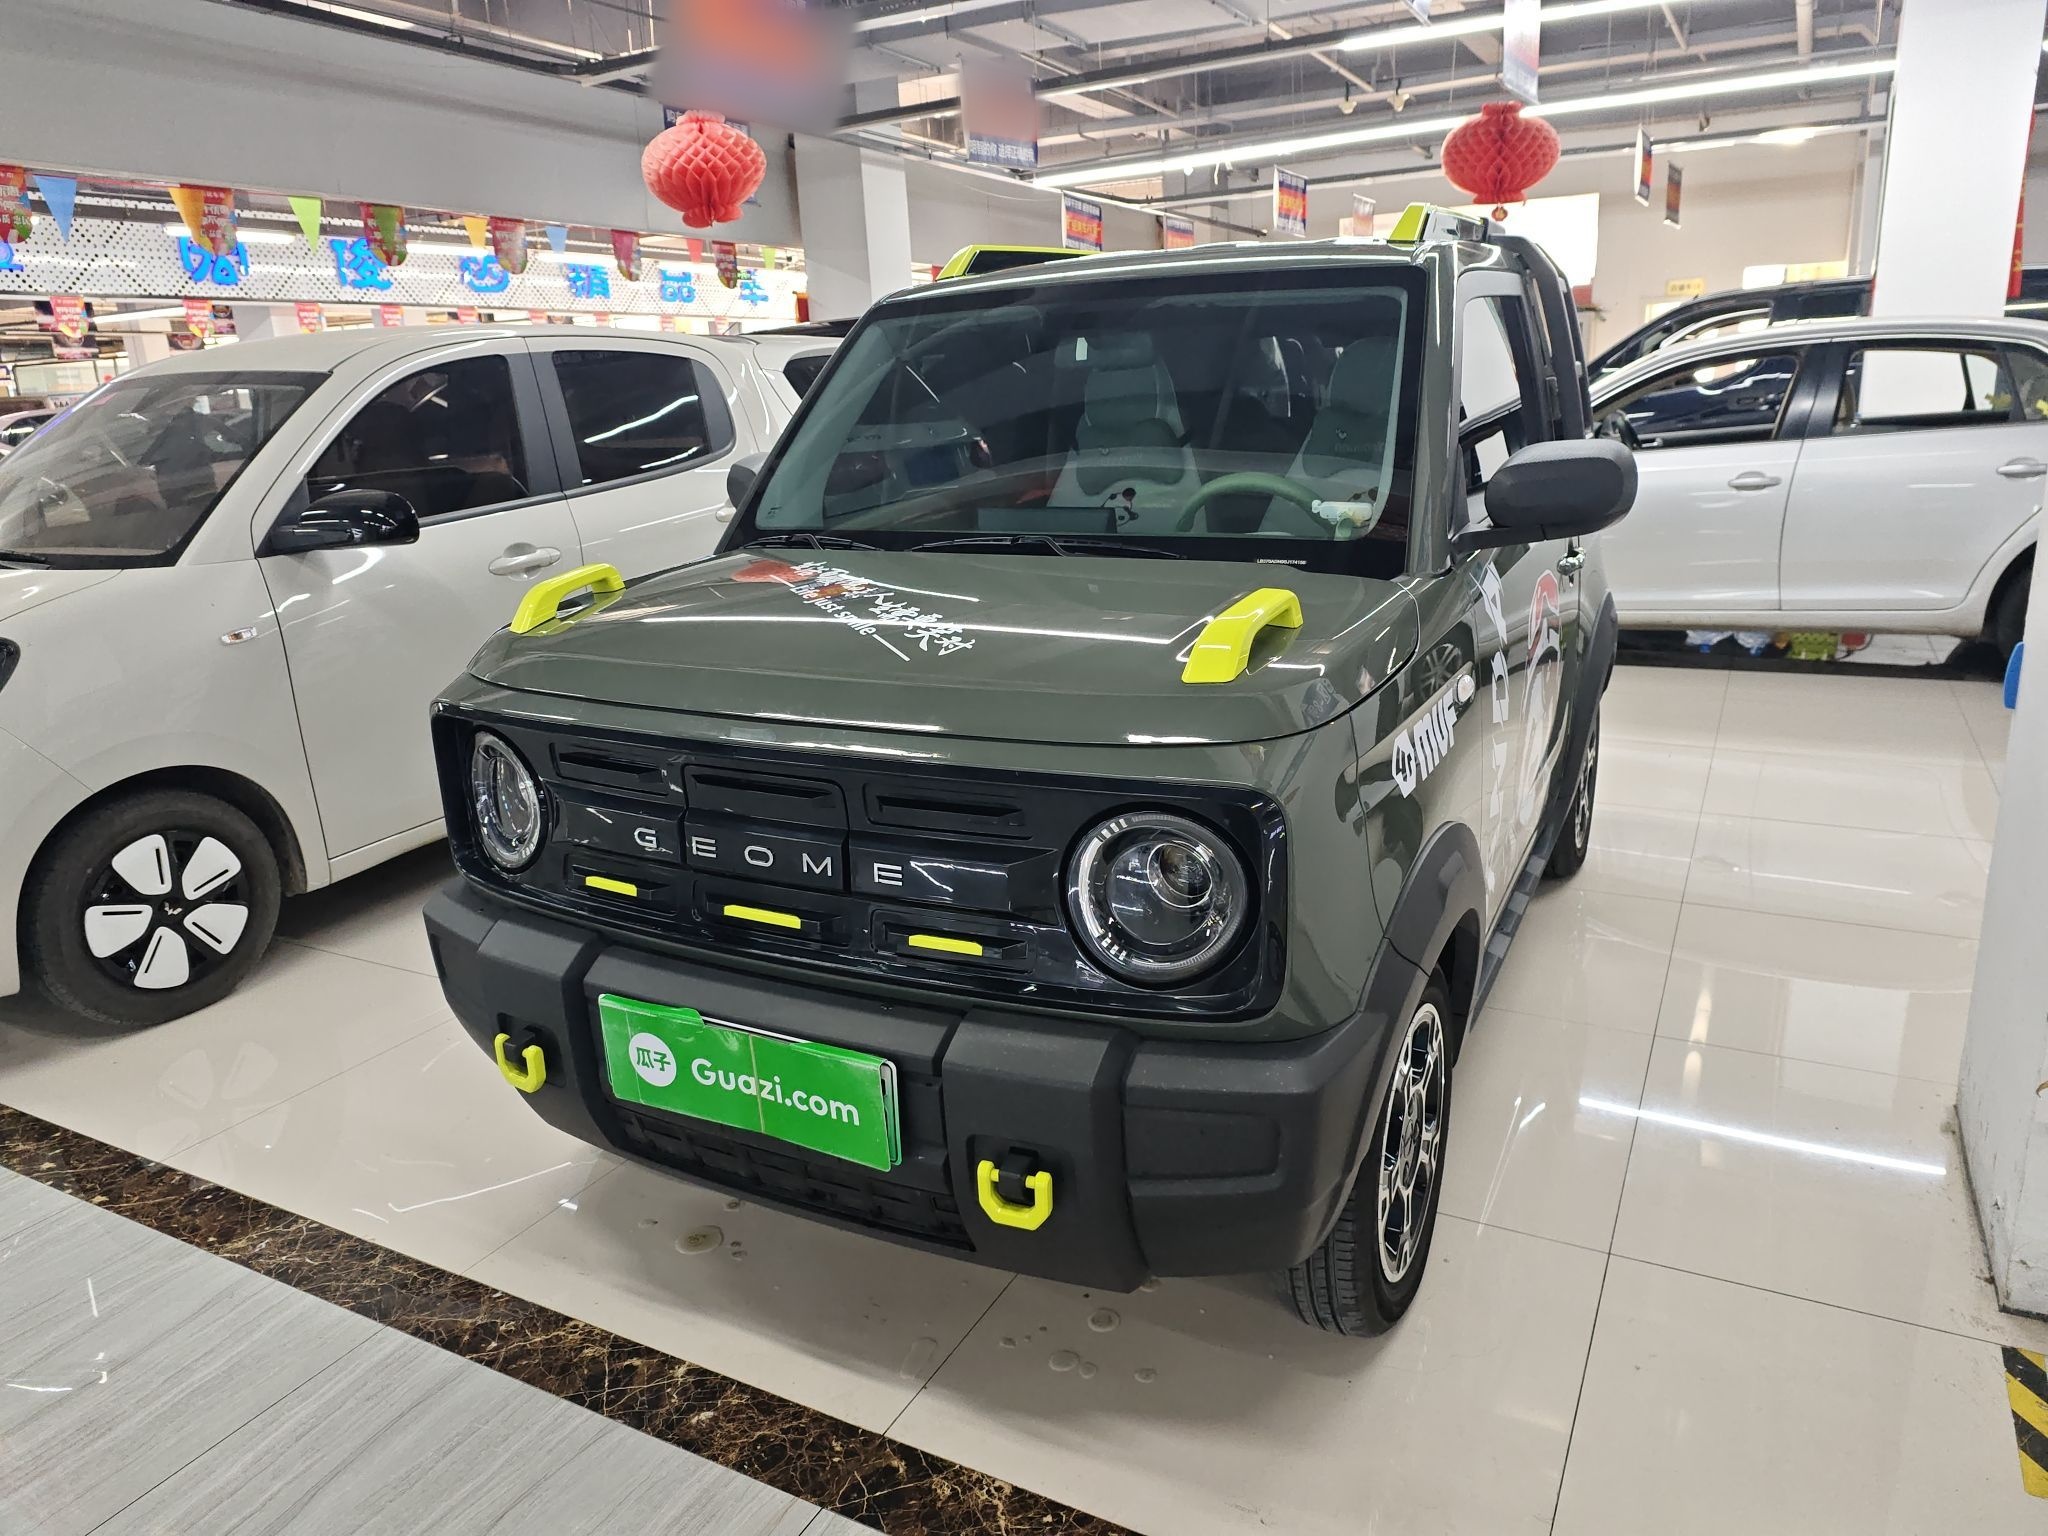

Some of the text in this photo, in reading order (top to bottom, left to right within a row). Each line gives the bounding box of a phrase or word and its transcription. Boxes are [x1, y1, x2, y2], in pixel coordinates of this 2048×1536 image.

[790, 584, 876, 636] Life just smile
[633, 827, 904, 887] GEOME
[635, 1045, 672, 1072] 瓜子
[690, 1057, 861, 1127] Guazi.com
